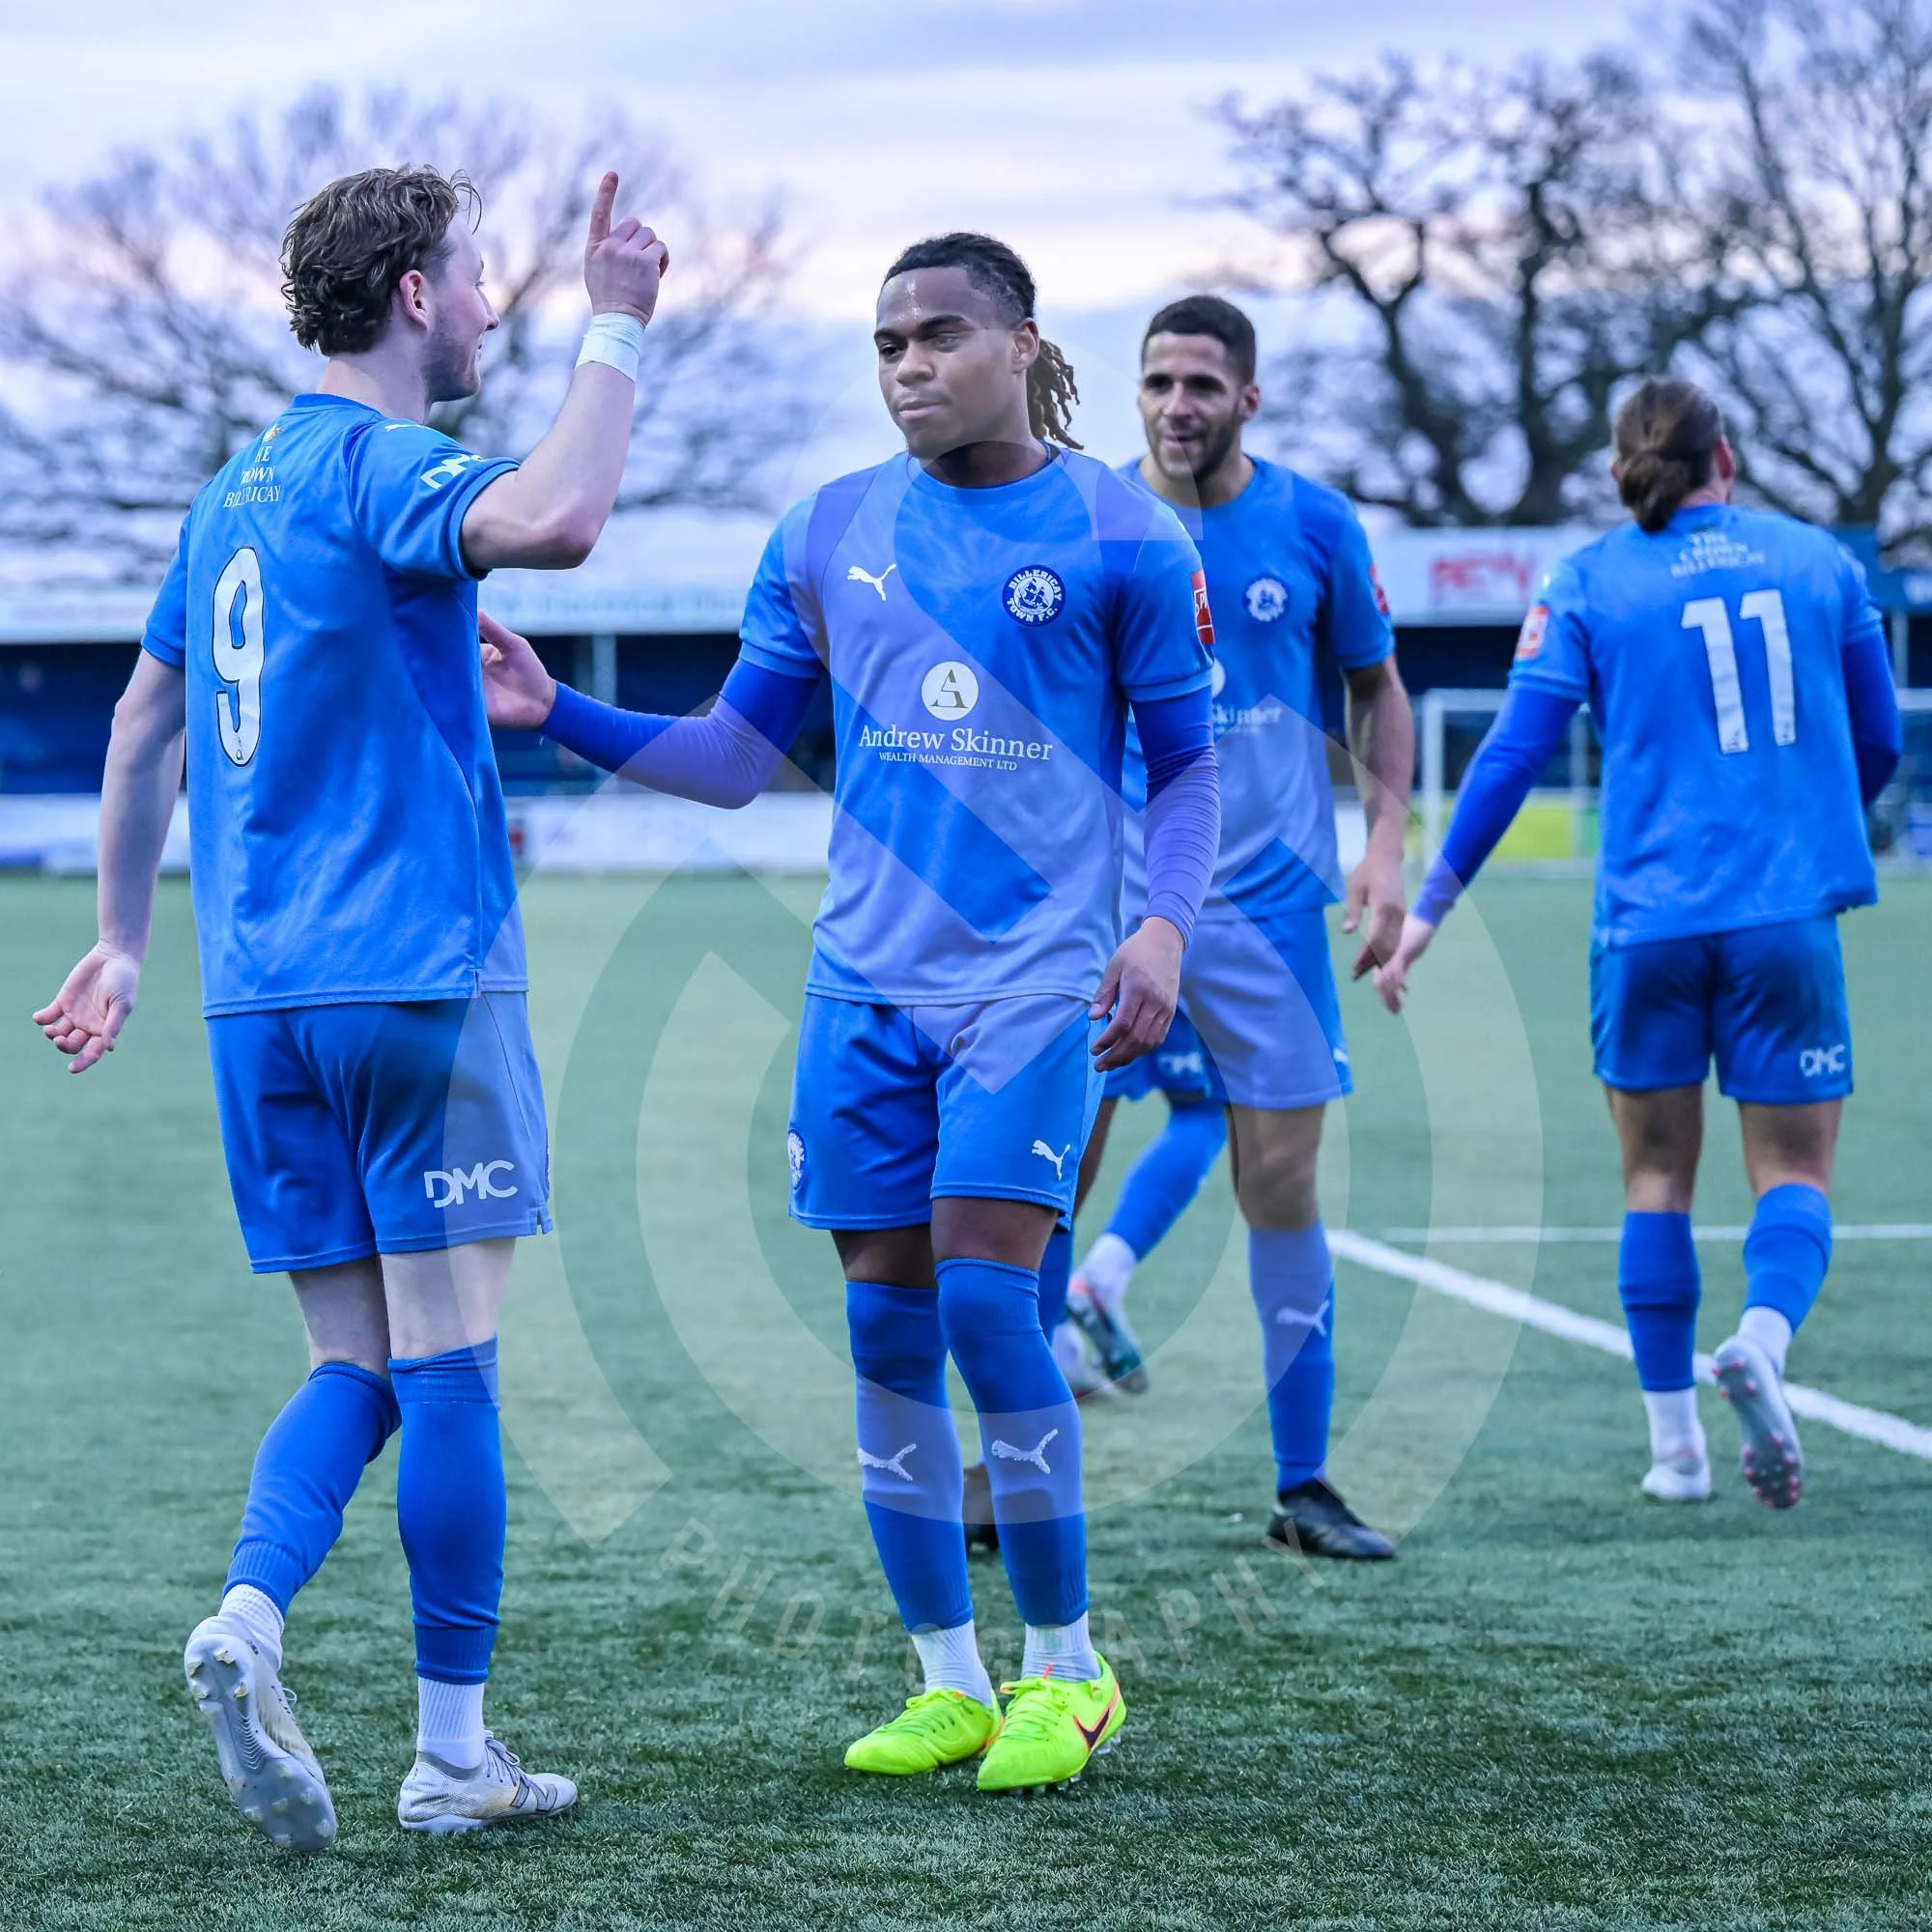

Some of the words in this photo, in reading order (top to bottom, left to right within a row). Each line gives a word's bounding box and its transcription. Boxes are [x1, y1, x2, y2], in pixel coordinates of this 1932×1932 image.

[1008, 569, 1063, 601] BILLERICAY
[1007, 597, 1035, 622] TOWN
[212, 547, 264, 767] 9
[1681, 588, 1796, 754] 11
[858, 724, 946, 750] Andrew
[951, 727, 1053, 761] Skinner
[879, 752, 916, 763] WEALTH
[919, 753, 994, 769] MANAGEMENT
[997, 759, 1017, 771] LTD
[1800, 1044, 1846, 1077] DMC
[423, 1159, 518, 1208] DMC
